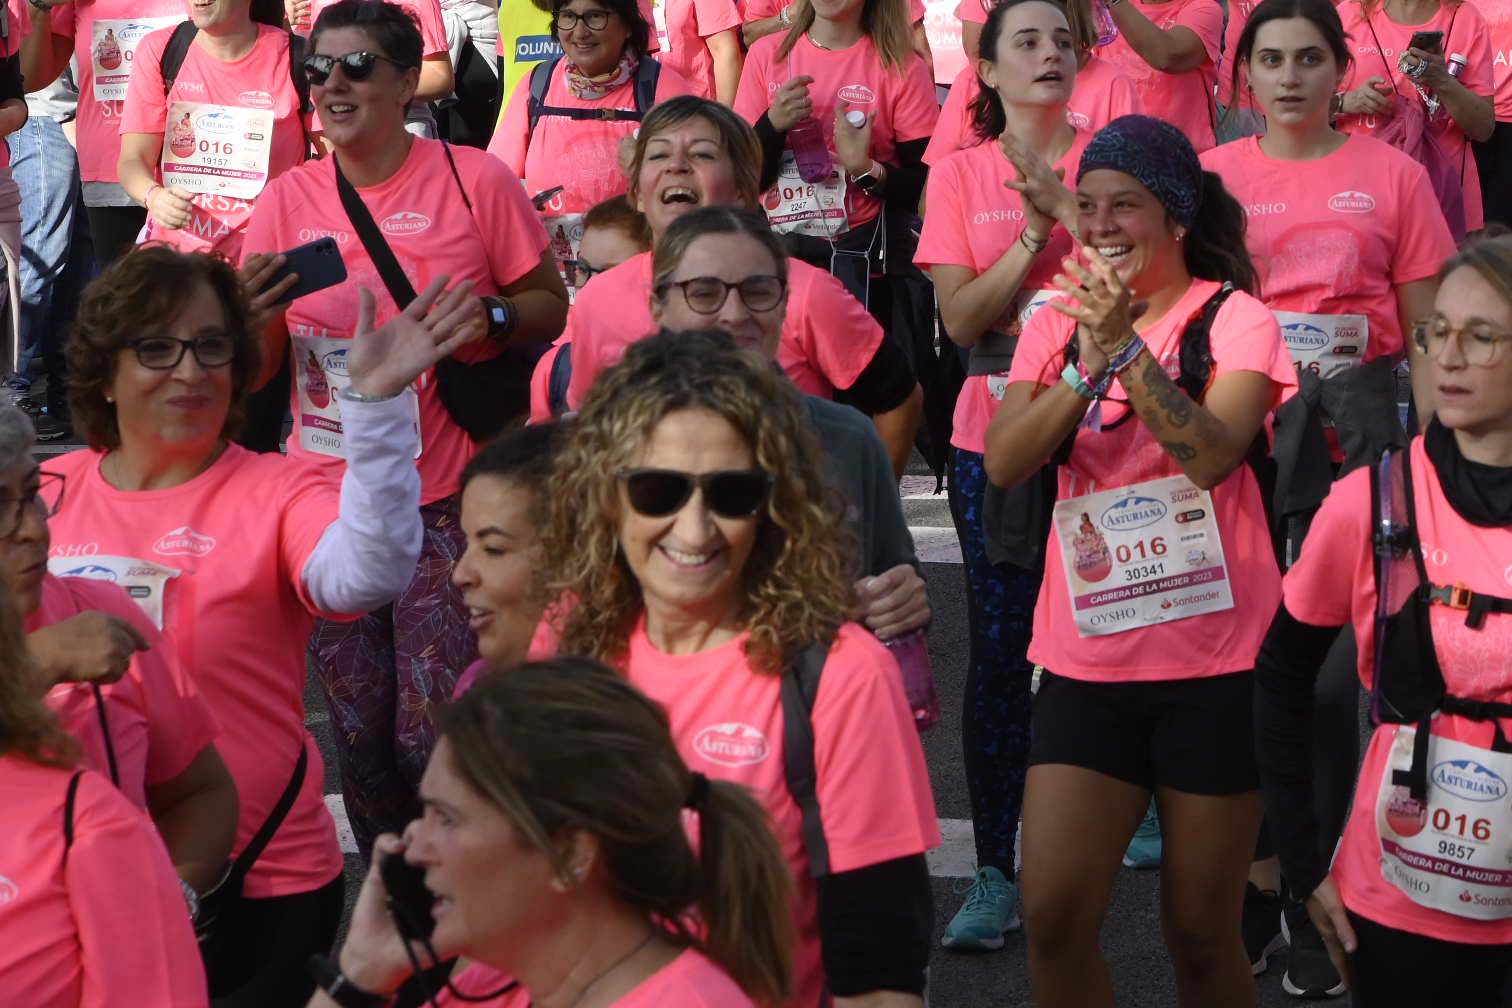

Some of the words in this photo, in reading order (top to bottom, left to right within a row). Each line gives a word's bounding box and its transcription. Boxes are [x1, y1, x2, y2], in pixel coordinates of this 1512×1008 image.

[199, 140, 233, 155] 016
[174, 165, 203, 174] CARRERA
[202, 157, 228, 167] 19157
[170, 177, 203, 186] OYSHO
[385, 220, 427, 232] ASTURIANA
[974, 209, 1024, 225] OYSHO
[299, 228, 349, 243] OYSHO
[311, 434, 341, 449] OYSHO
[1171, 492, 1200, 503] SUMA
[1106, 507, 1163, 527] ASTURIANA
[1115, 536, 1168, 564] 016
[1124, 563, 1165, 581] 30341
[1090, 590, 1131, 604] CARRERA
[1132, 585, 1145, 594] DE
[1145, 583, 1158, 592] LA
[1159, 577, 1190, 590] MUJER
[1172, 591, 1220, 609] Santander
[1090, 607, 1136, 626] OYSHO
[1436, 769, 1501, 797] ASTURIANA
[1432, 808, 1493, 841] 016
[1438, 840, 1476, 861] 9857
[1435, 863, 1449, 873] DE
[1451, 866, 1464, 876] LA
[1466, 870, 1502, 883] MUJER
